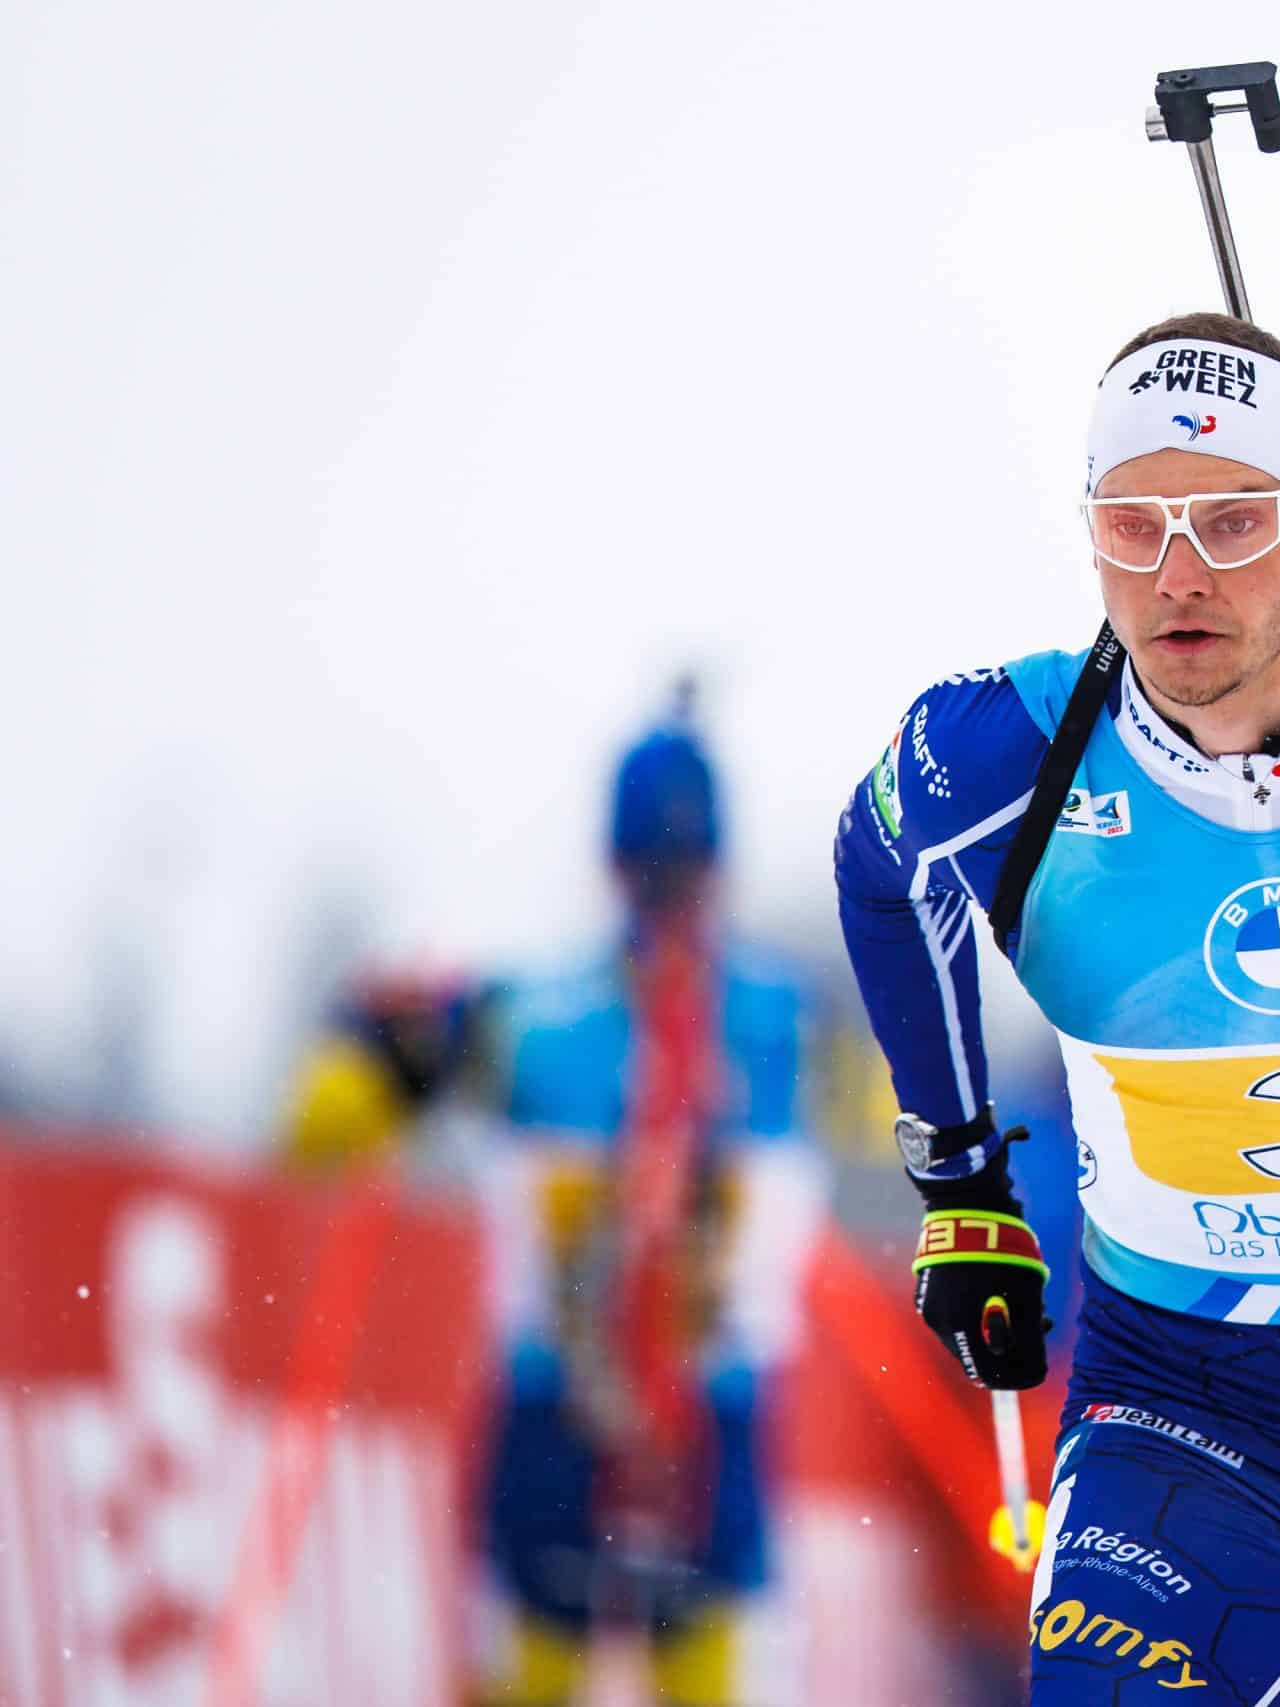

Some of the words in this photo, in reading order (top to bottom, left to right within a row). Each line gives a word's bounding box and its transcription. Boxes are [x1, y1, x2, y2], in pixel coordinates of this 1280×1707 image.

[1156, 350, 1256, 384] GREEN
[1164, 369, 1257, 409] WEEZ
[1096, 636, 1119, 673] ain
[912, 703, 938, 777] CRAFT
[1126, 685, 1184, 762] RAFT
[917, 1219, 999, 1252] LE
[1205, 1231, 1265, 1257] Das
[1112, 1408, 1175, 1433] Jean
[1072, 1526, 1193, 1595] Région
